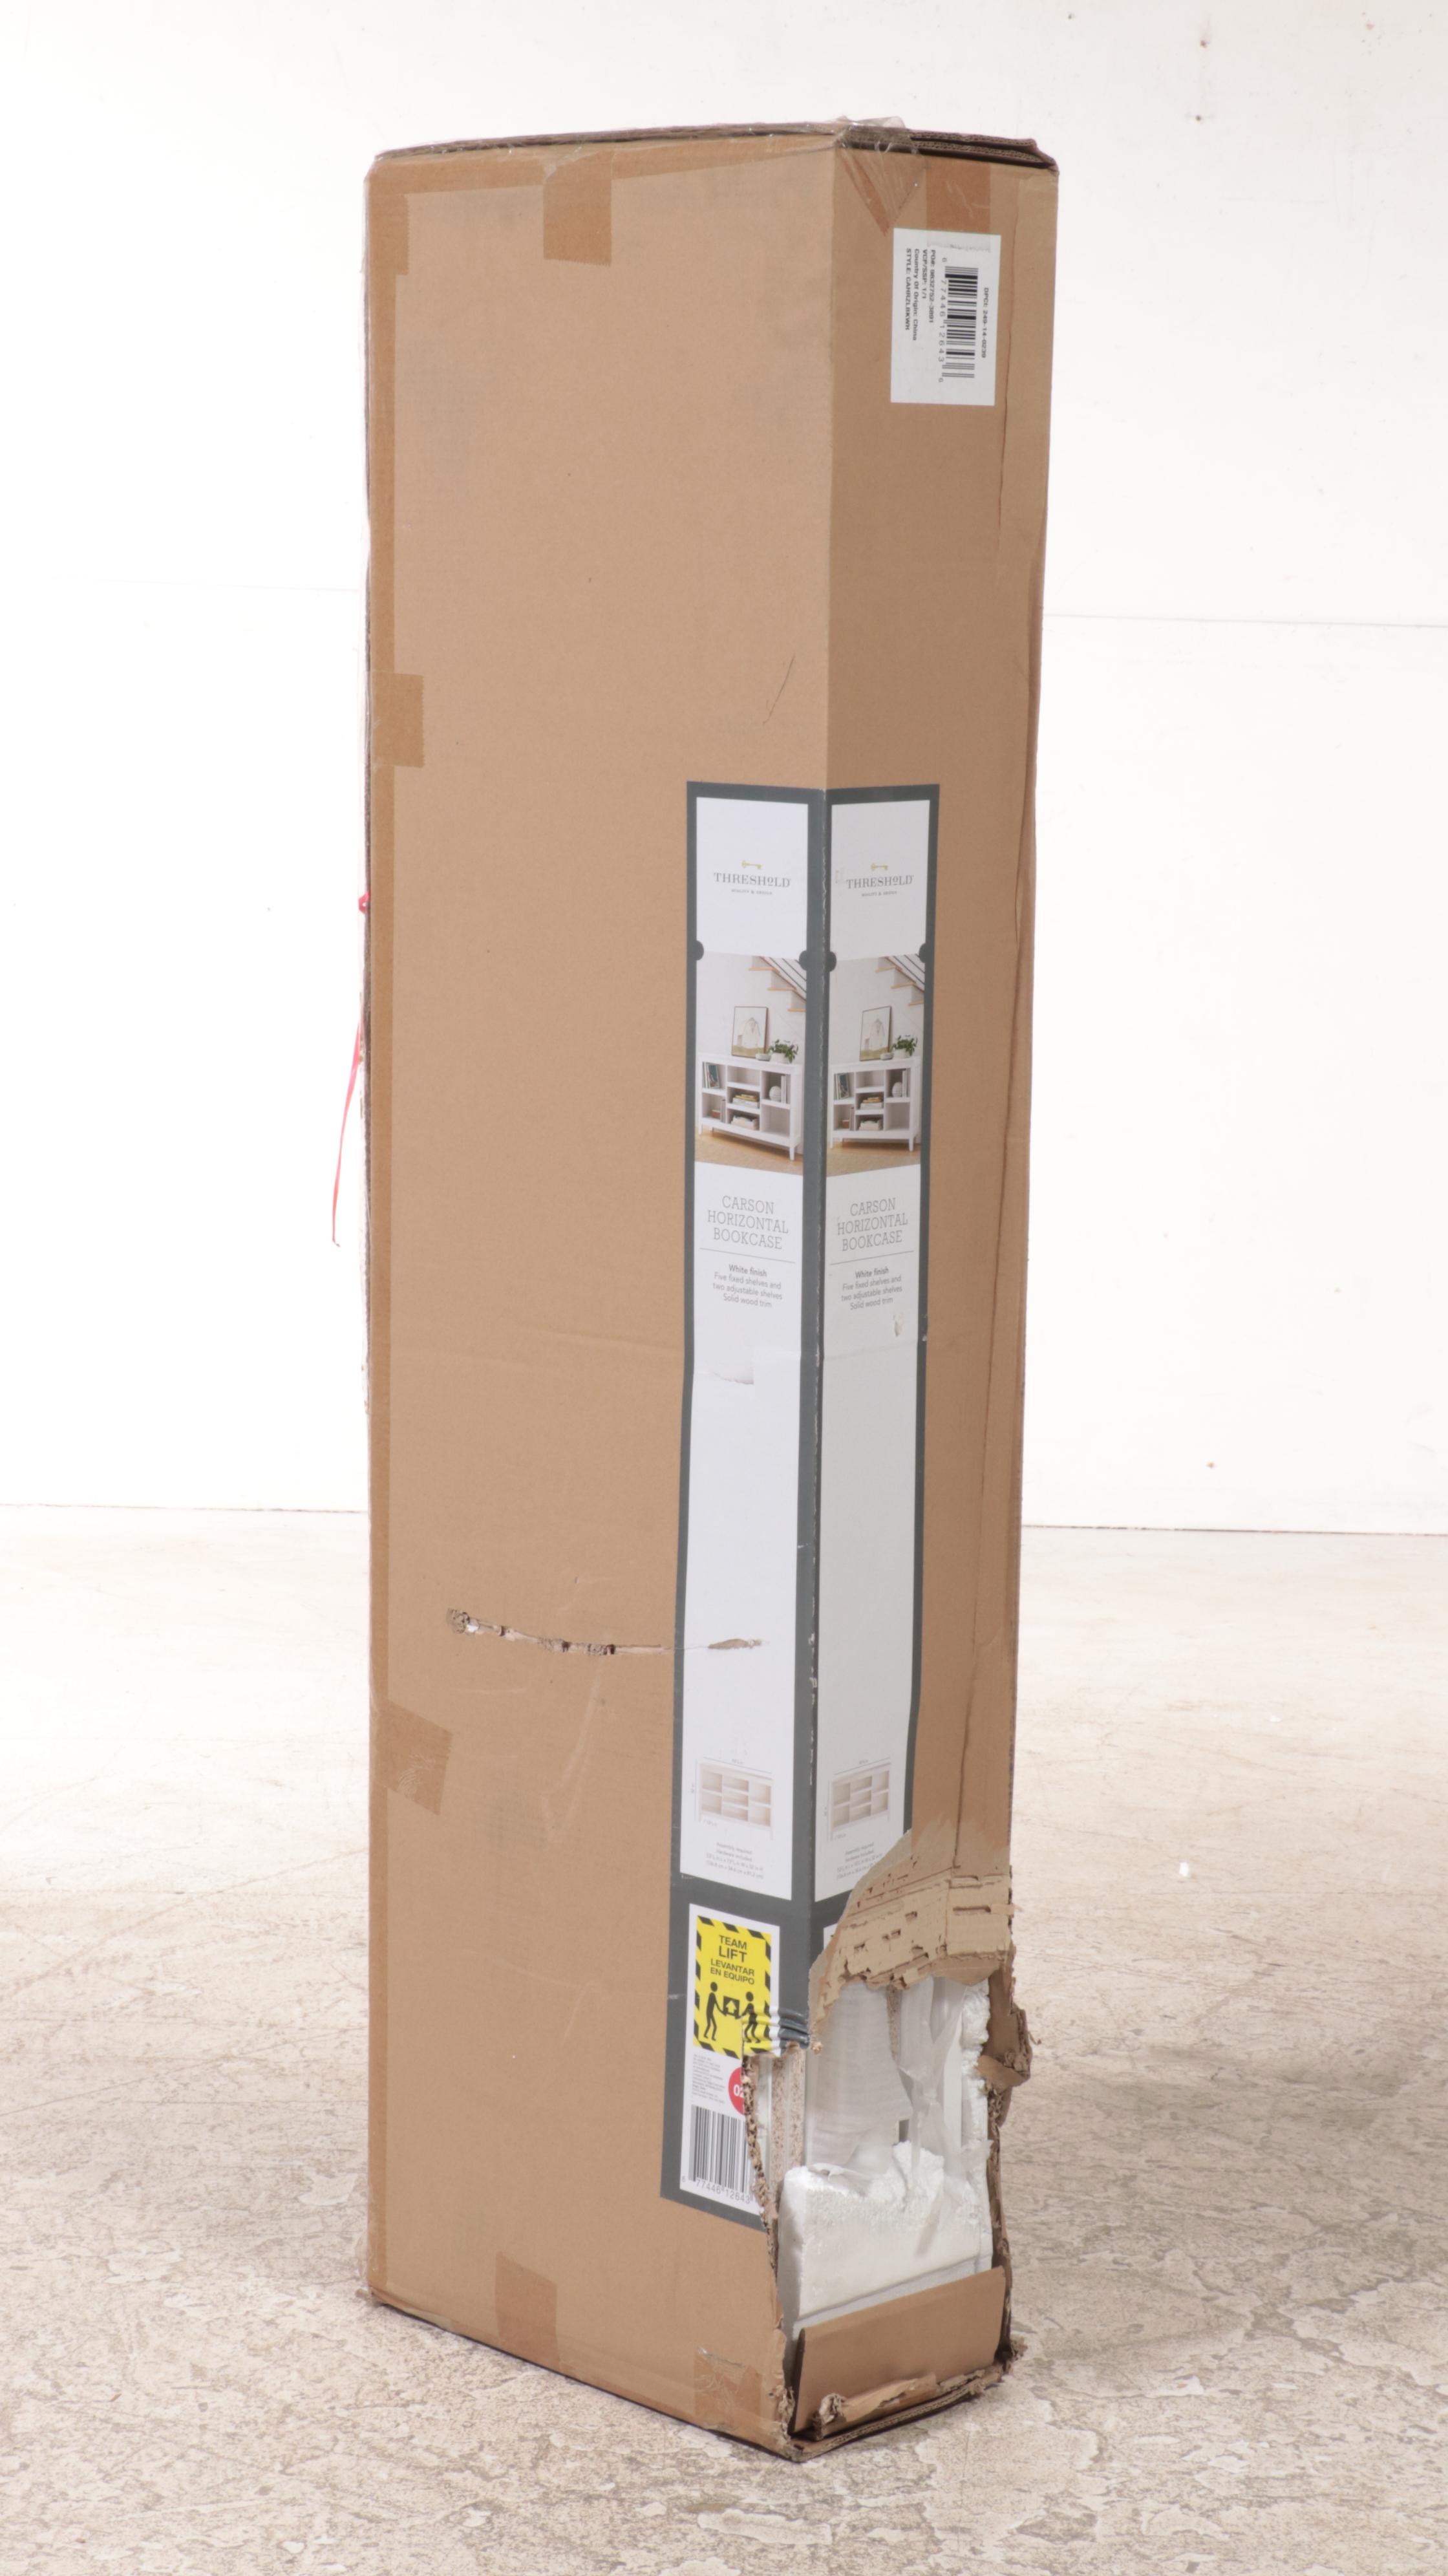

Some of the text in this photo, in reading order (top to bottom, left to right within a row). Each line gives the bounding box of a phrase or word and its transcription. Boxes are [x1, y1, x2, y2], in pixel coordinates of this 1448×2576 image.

[914, 281, 919, 290] Of
[713, 872, 791, 888] THRESHOLD
[846, 874, 914, 890] THRESHOLD
[722, 1195, 774, 1214] CARSON
[850, 1197, 896, 1216] CARSON
[707, 1210, 789, 1234] HORIZONTAL
[837, 1212, 908, 1236] HORIZONTAL
[714, 1227, 782, 1250] BOOKCASE
[842, 1230, 902, 1252] BOOKCASE
[729, 1263, 767, 1277] White finish
[855, 1267, 889, 1279] White finish
[714, 1271, 727, 1281] Five
[729, 1274, 744, 1283] fixed
[745, 1278, 768, 1287] shelves
[842, 1274, 901, 1291] Five fixed shelves and
[727, 1284, 759, 1296] adjustable
[760, 1290, 782, 1300] shelves
[853, 1289, 881, 1300] adjustable
[883, 1285, 902, 1294] shelves
[723, 1293, 772, 1308] Solid wood trim
[850, 1301, 864, 1310] Solid
[865, 1299, 880, 1307] wood
[719, 1935, 747, 1950] TEAM
[719, 1946, 747, 1962] LIFT
[710, 1958, 755, 1976] LEVANTAR
[710, 1967, 755, 1985] EN EQUIPO
[696, 2179, 721, 2195] 77446
[725, 2189, 751, 2204] 12643
